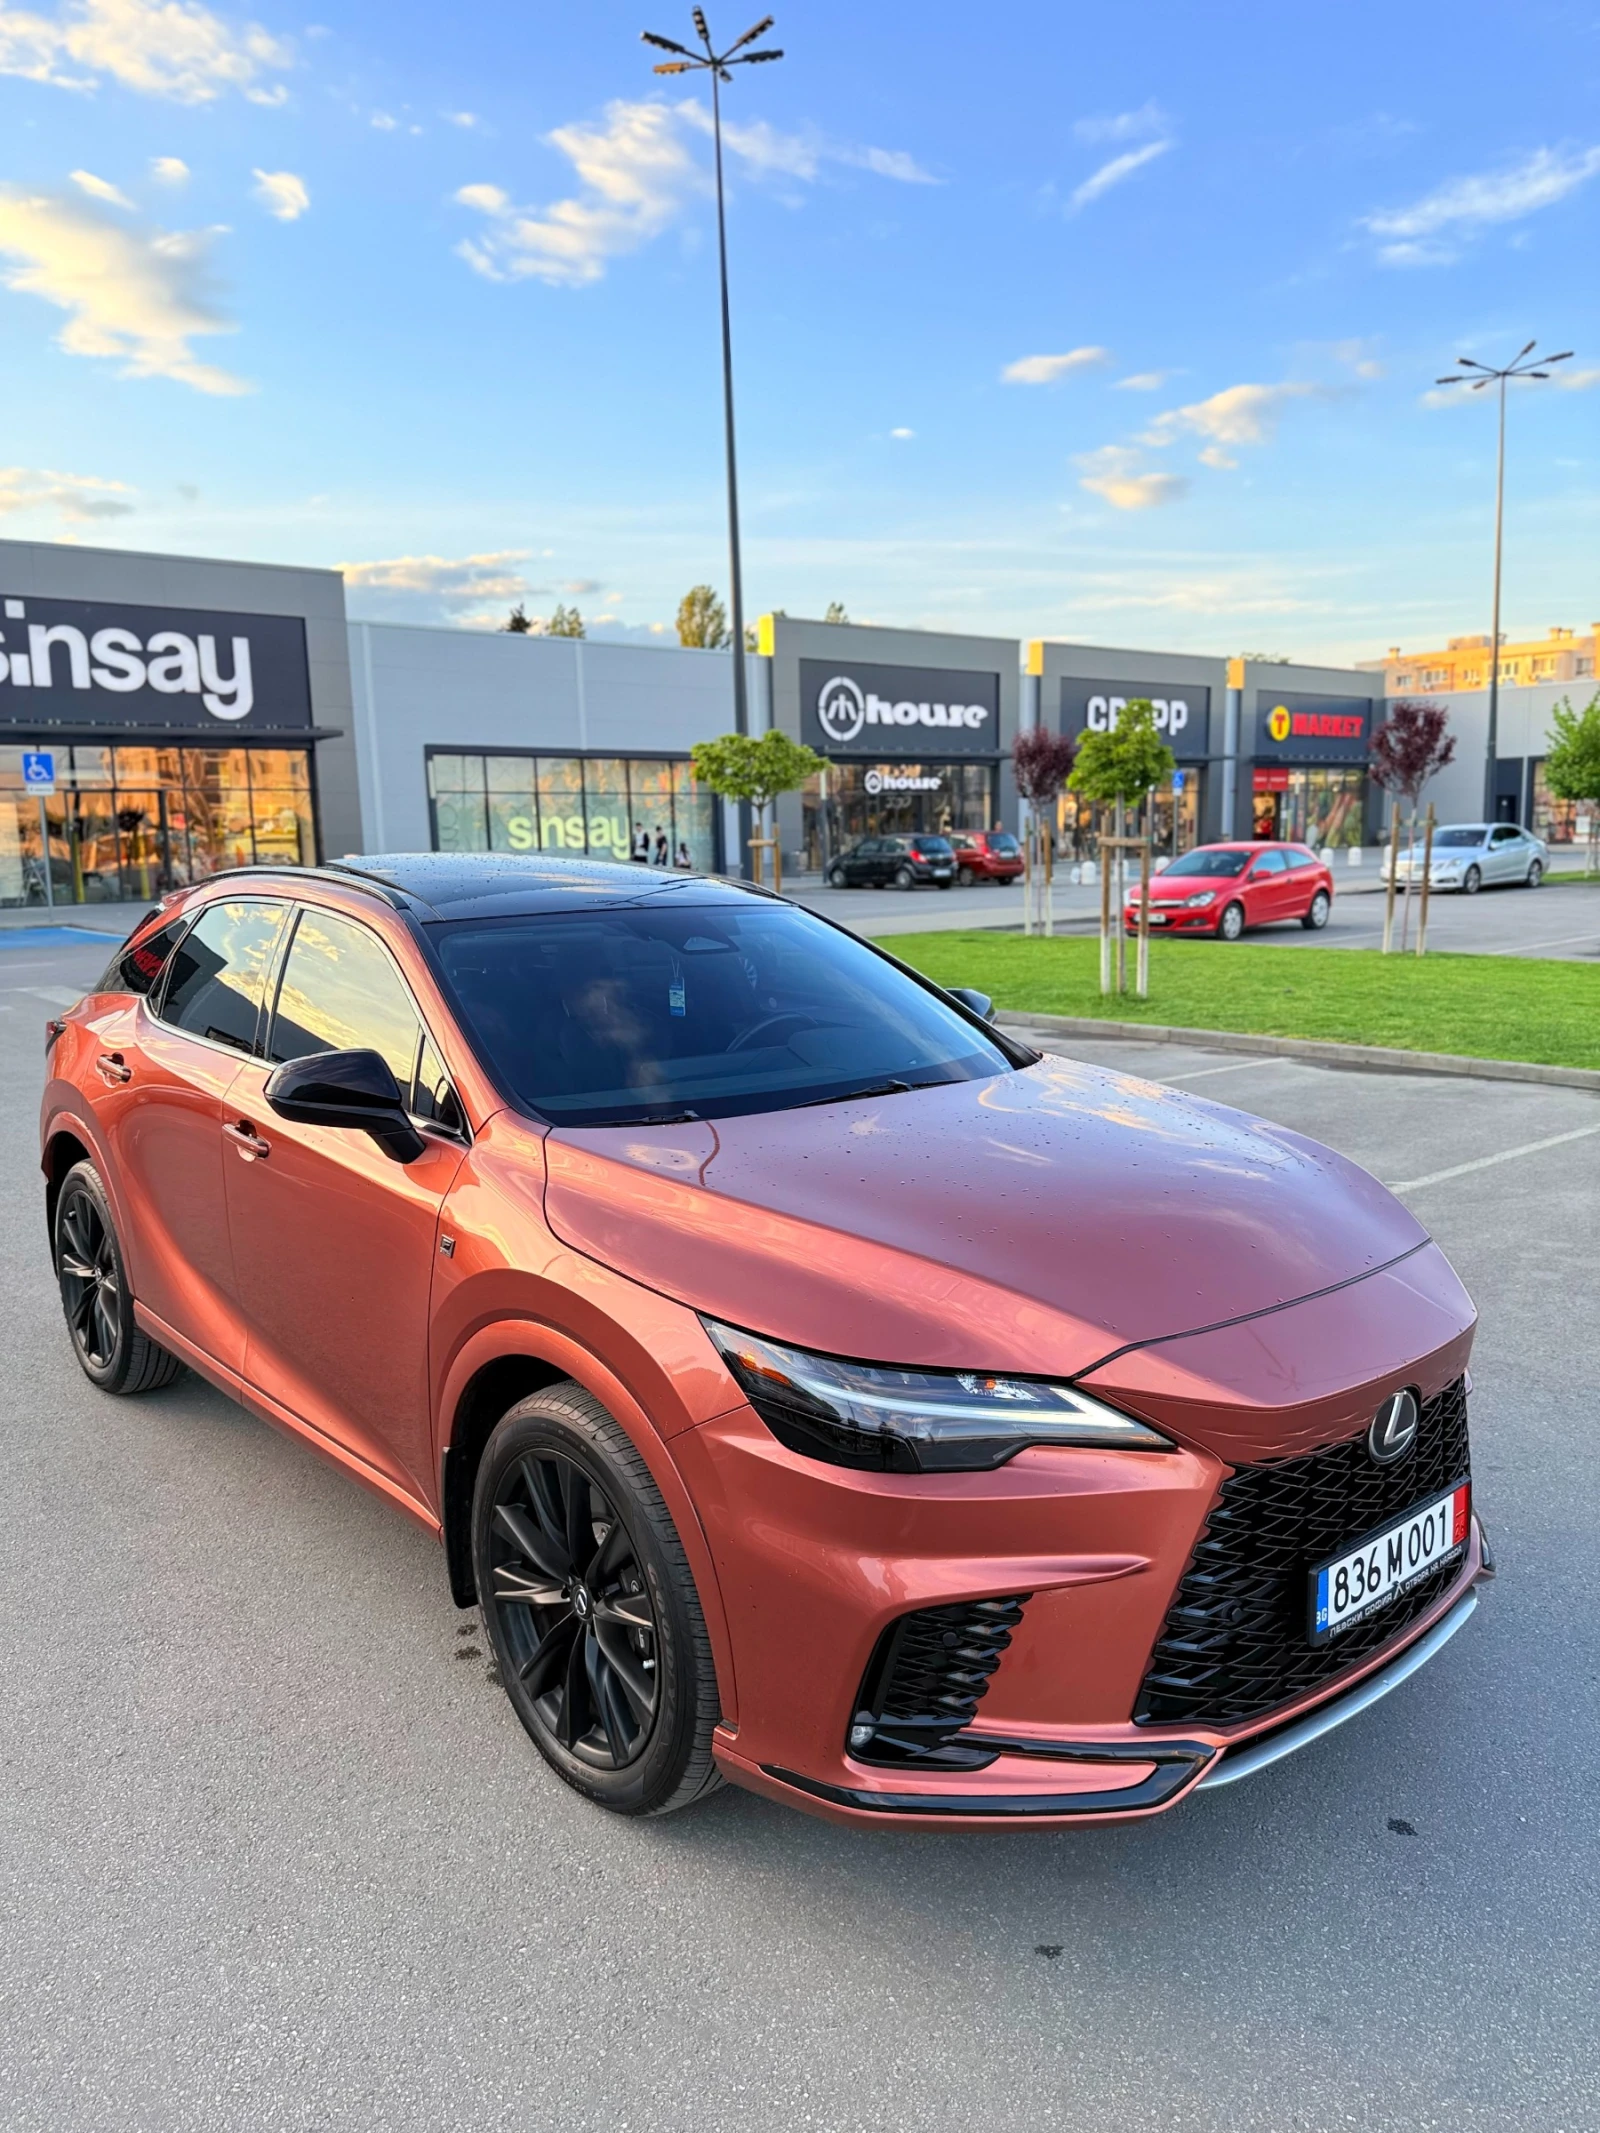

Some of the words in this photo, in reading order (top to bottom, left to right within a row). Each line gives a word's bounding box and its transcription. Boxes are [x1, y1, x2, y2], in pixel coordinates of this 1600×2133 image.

[0, 599, 254, 720] insay
[865, 693, 988, 728] house
[1087, 696, 1188, 736] CRPP
[1292, 711, 1363, 738] MARKET
[883, 774, 942, 790] house
[1334, 1546, 1382, 1614] 836
[1387, 1531, 1403, 1583] M
[1408, 1504, 1446, 1567] 001
[1329, 1610, 1363, 1638] ЛЕВСКИ
[1364, 1592, 1393, 1616] СОФИЯ
